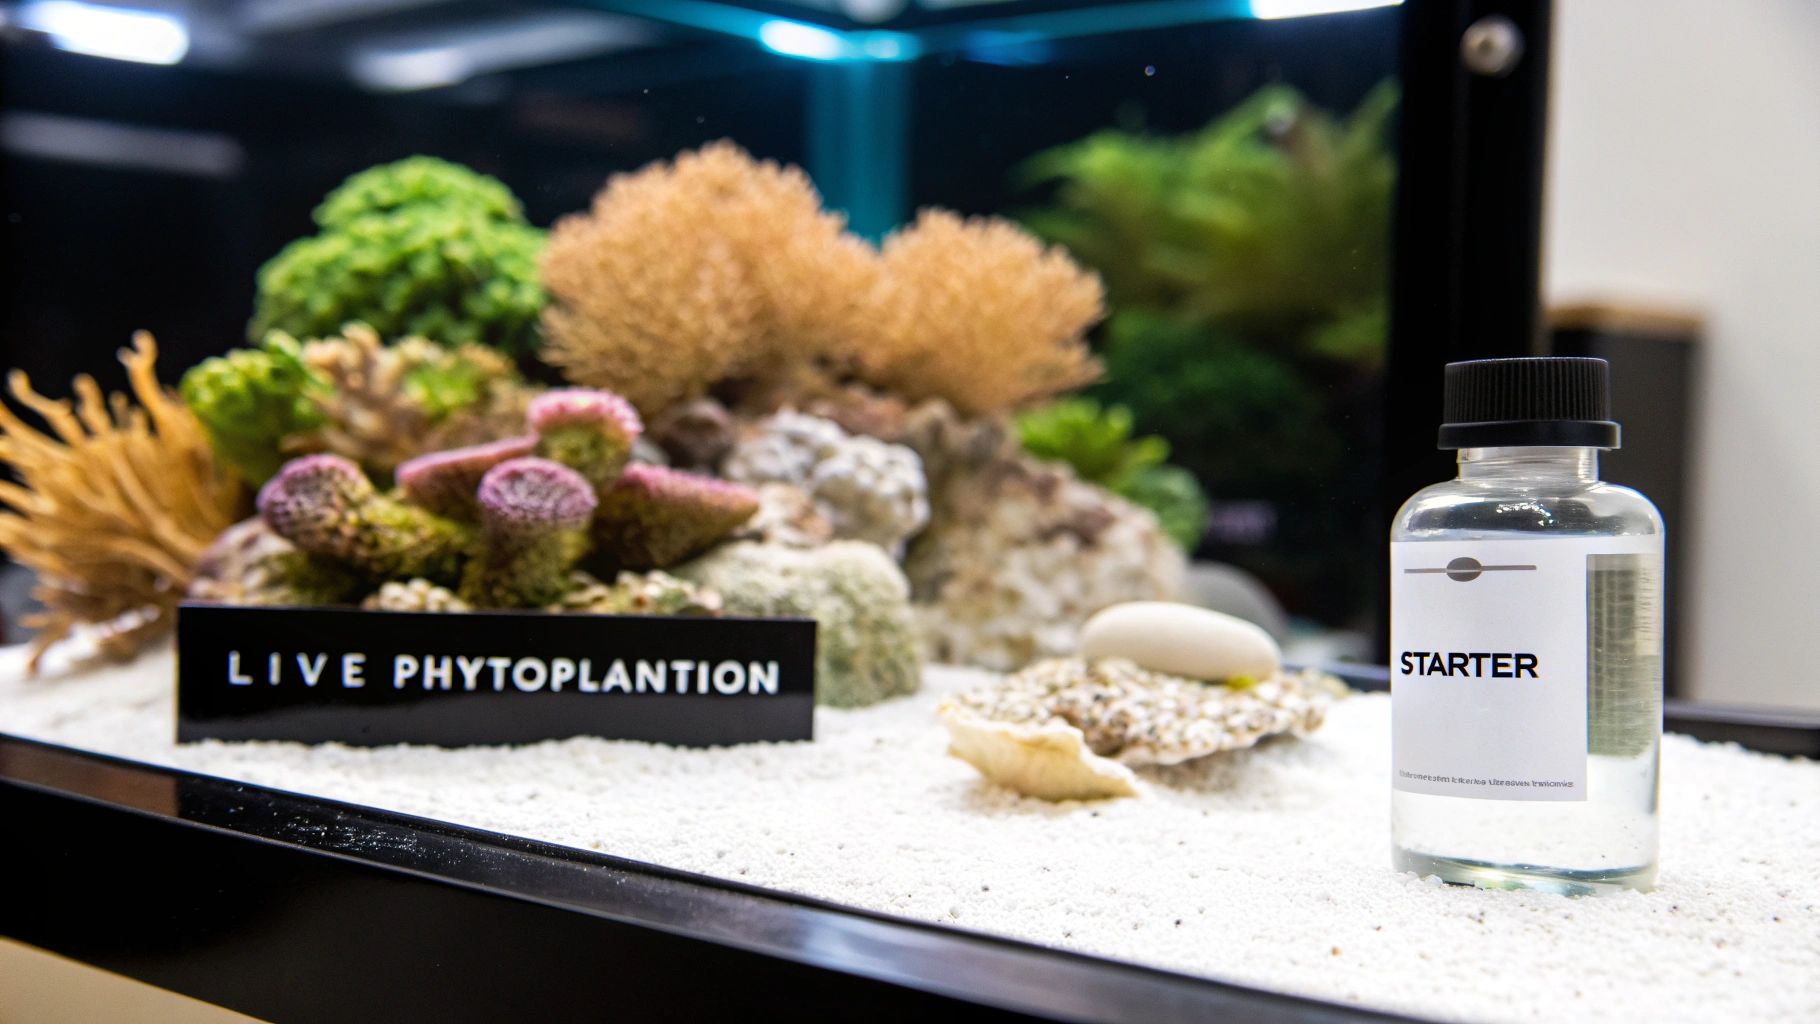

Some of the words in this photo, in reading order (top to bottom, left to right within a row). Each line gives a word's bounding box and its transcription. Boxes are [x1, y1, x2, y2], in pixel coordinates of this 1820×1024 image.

[228, 652, 366, 687] LIVE
[394, 655, 780, 695] PHYTOPLANTION
[1400, 651, 1539, 679] STARTER
